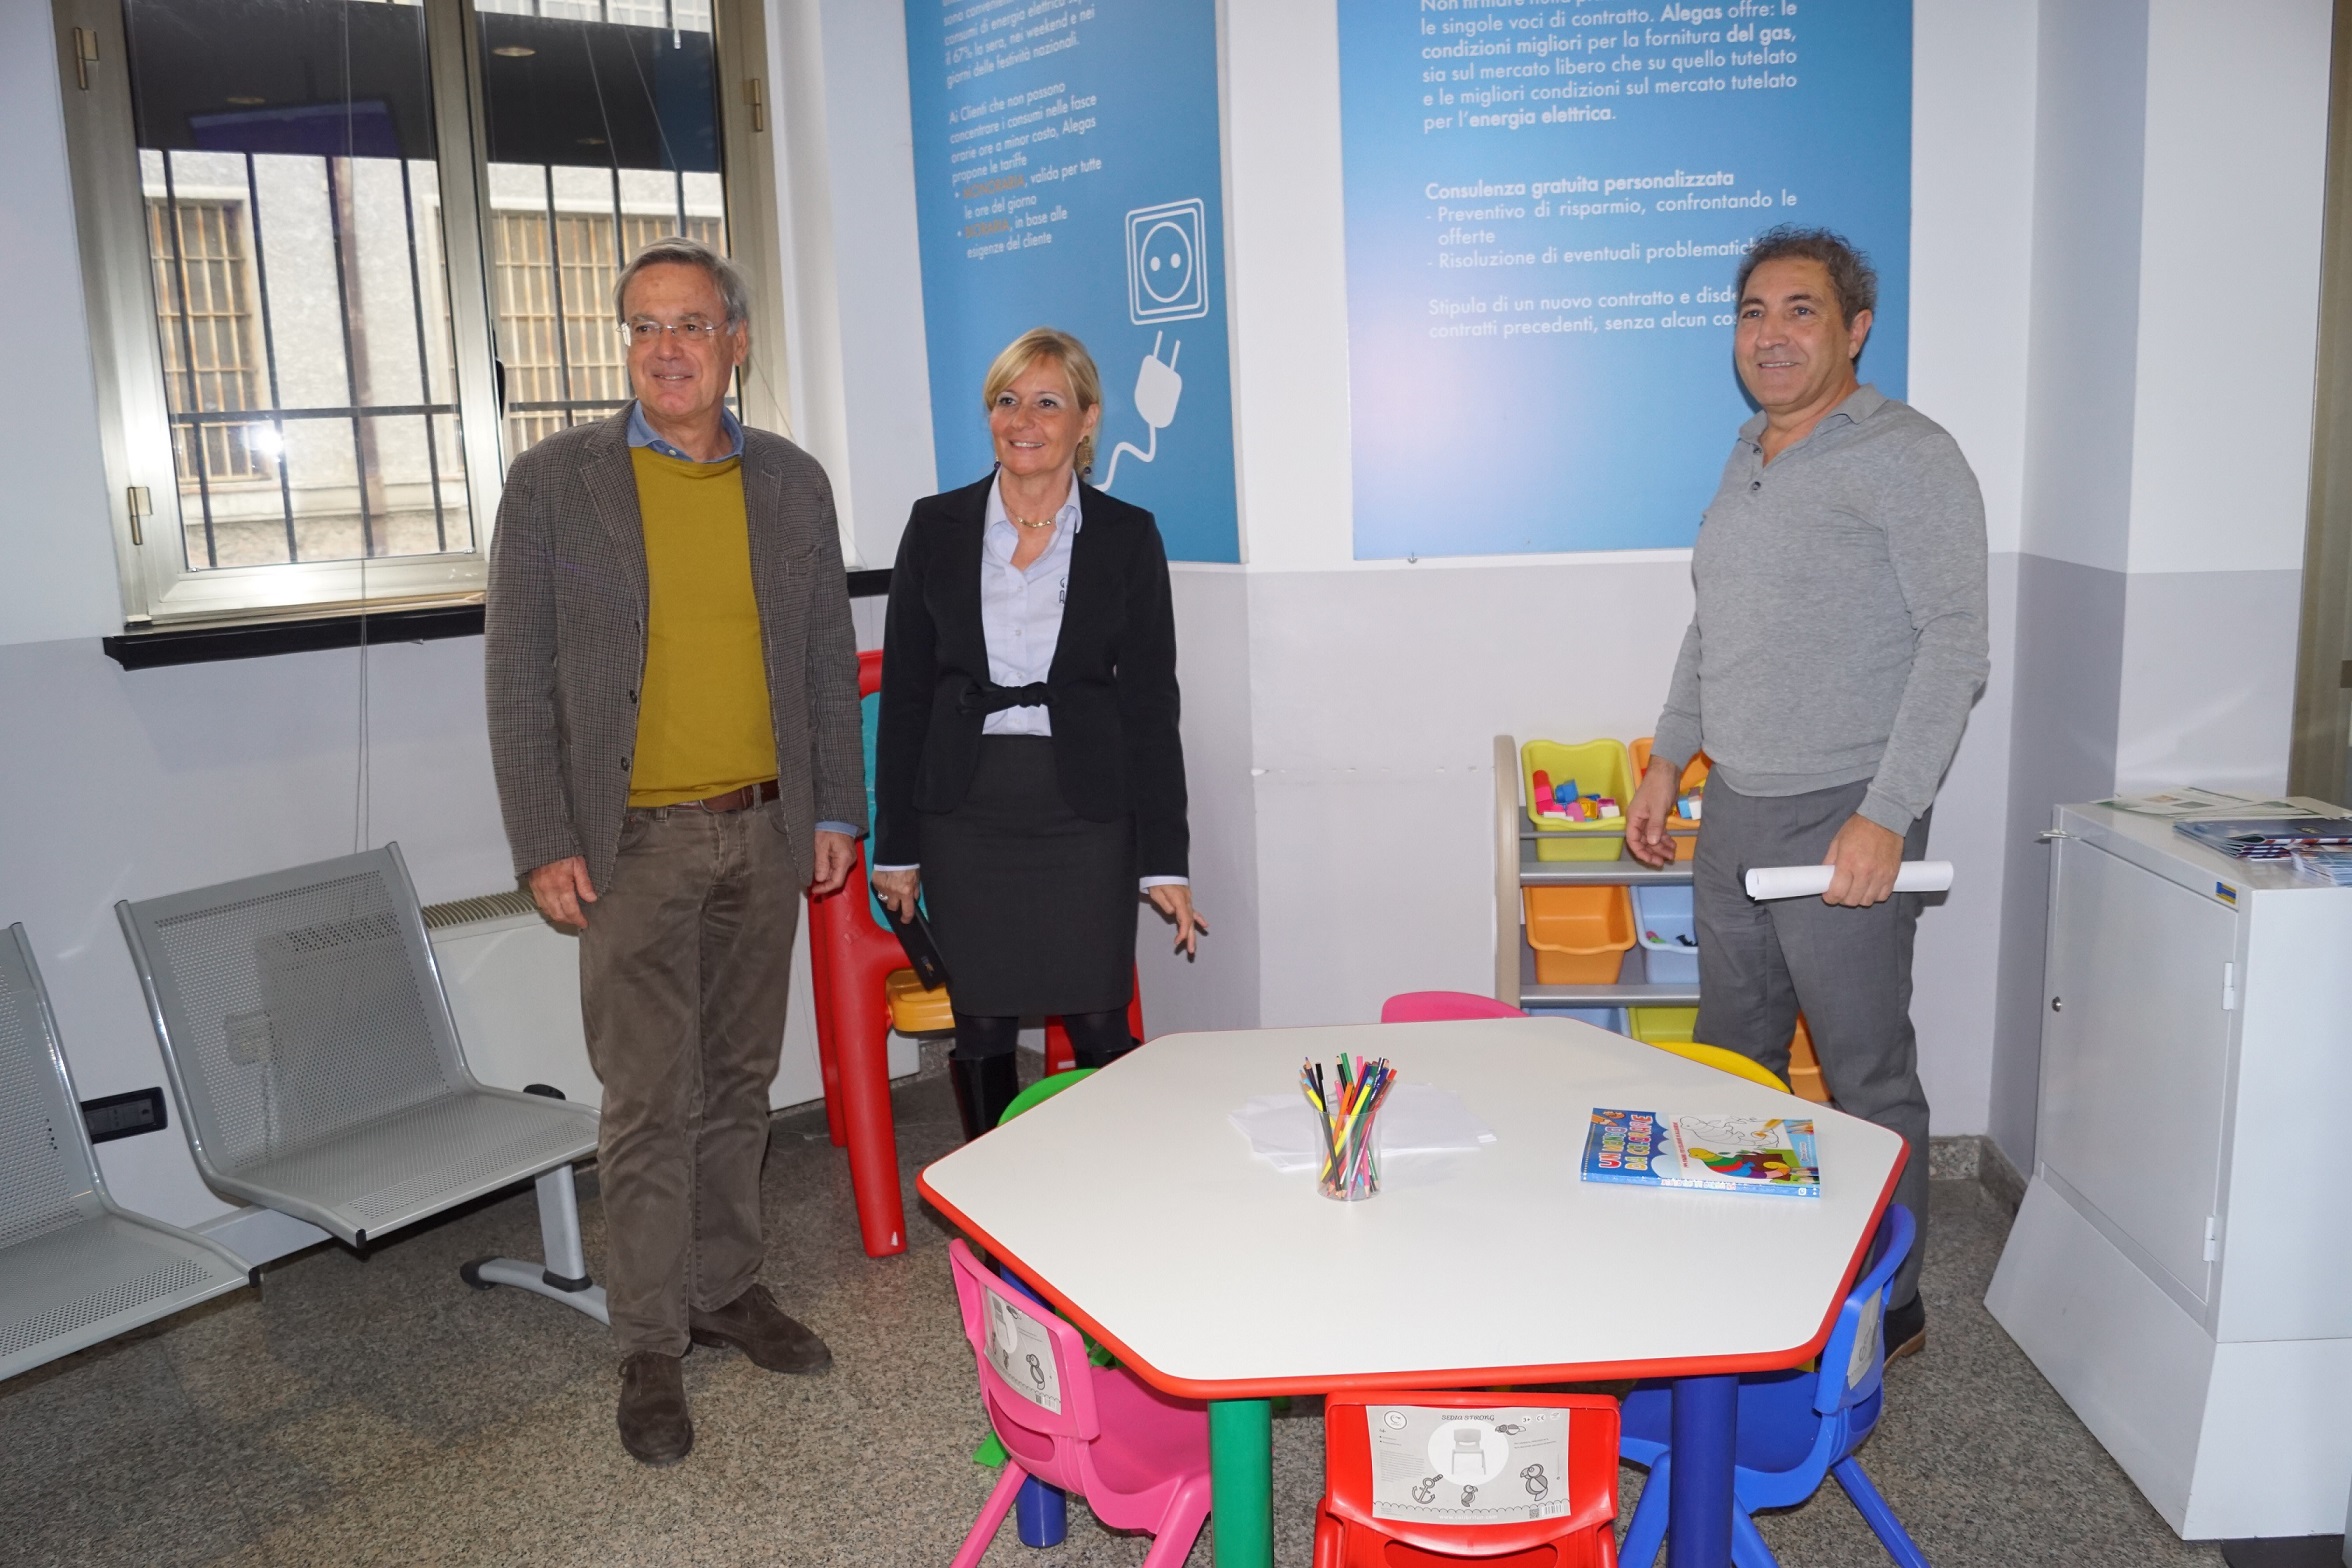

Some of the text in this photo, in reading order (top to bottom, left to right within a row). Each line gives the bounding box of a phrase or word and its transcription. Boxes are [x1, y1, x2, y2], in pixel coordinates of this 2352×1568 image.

[1420, 0, 1458, 12] Non
[1421, 0, 1797, 38] le singole voci di contratto. Alegas offre: le
[944, 22, 978, 46] consumi
[980, 18, 988, 33] di
[991, 8, 1026, 30] energia
[985, 38, 1006, 52] sera,
[1009, 27, 1024, 44] nei
[1026, 11, 1068, 38] weekend
[1070, 13, 1077, 25] e
[1080, 3, 1095, 22] nei
[1422, 22, 1797, 60] condizioni migliori per la fornitura del gas,
[946, 66, 971, 90] giorni
[973, 59, 994, 78] delle
[1033, 30, 1080, 58] nazionali.
[1422, 46, 1798, 82] sia sul mercato libero che su quello tutelato
[950, 82, 1066, 124] Ai Clienti che non possono
[1424, 70, 1798, 108] e le migliori condizioni sul mercato tutelato
[950, 120, 1000, 144] concentrare
[1008, 106, 1044, 128] consumi
[1046, 98, 1068, 118] nelle
[1070, 94, 1097, 111] fasce
[1424, 115, 1453, 135] per
[1541, 105, 1617, 124] elettrica.
[951, 117, 1096, 164] orarie ore a minor costo, Alegas
[952, 152, 1028, 185] propone le tariffe
[1030, 164, 1059, 184] valida
[1061, 164, 1078, 182] per
[1080, 157, 1102, 172] tutte
[1425, 170, 1735, 200] Consulenza gratuita personalizzata
[964, 194, 1037, 220] le ore del giorno
[1015, 215, 1024, 229] in
[1026, 212, 1048, 228] base
[1050, 205, 1068, 222] alle
[1438, 204, 1526, 222] Preventivo
[1534, 200, 1550, 218] di
[1560, 198, 1646, 221] risparmio,
[1656, 189, 1773, 212] confrontando
[1781, 188, 1797, 207] le
[966, 232, 1052, 261] esigenze del cliente
[1438, 227, 1496, 246] offerte
[1440, 250, 1536, 270] Risoluzione
[1542, 246, 1558, 265] di
[1564, 242, 1640, 264] eventuali
[1646, 238, 1756, 264] problematich
[1428, 284, 1738, 318] Stipula di un nuovo contratto e disde
[1428, 310, 1737, 340] contratti precedenti, senza alcun co
[1598, 1125, 1628, 1170] UN MONDO
[1624, 1114, 1654, 1172] DA COLORARE
